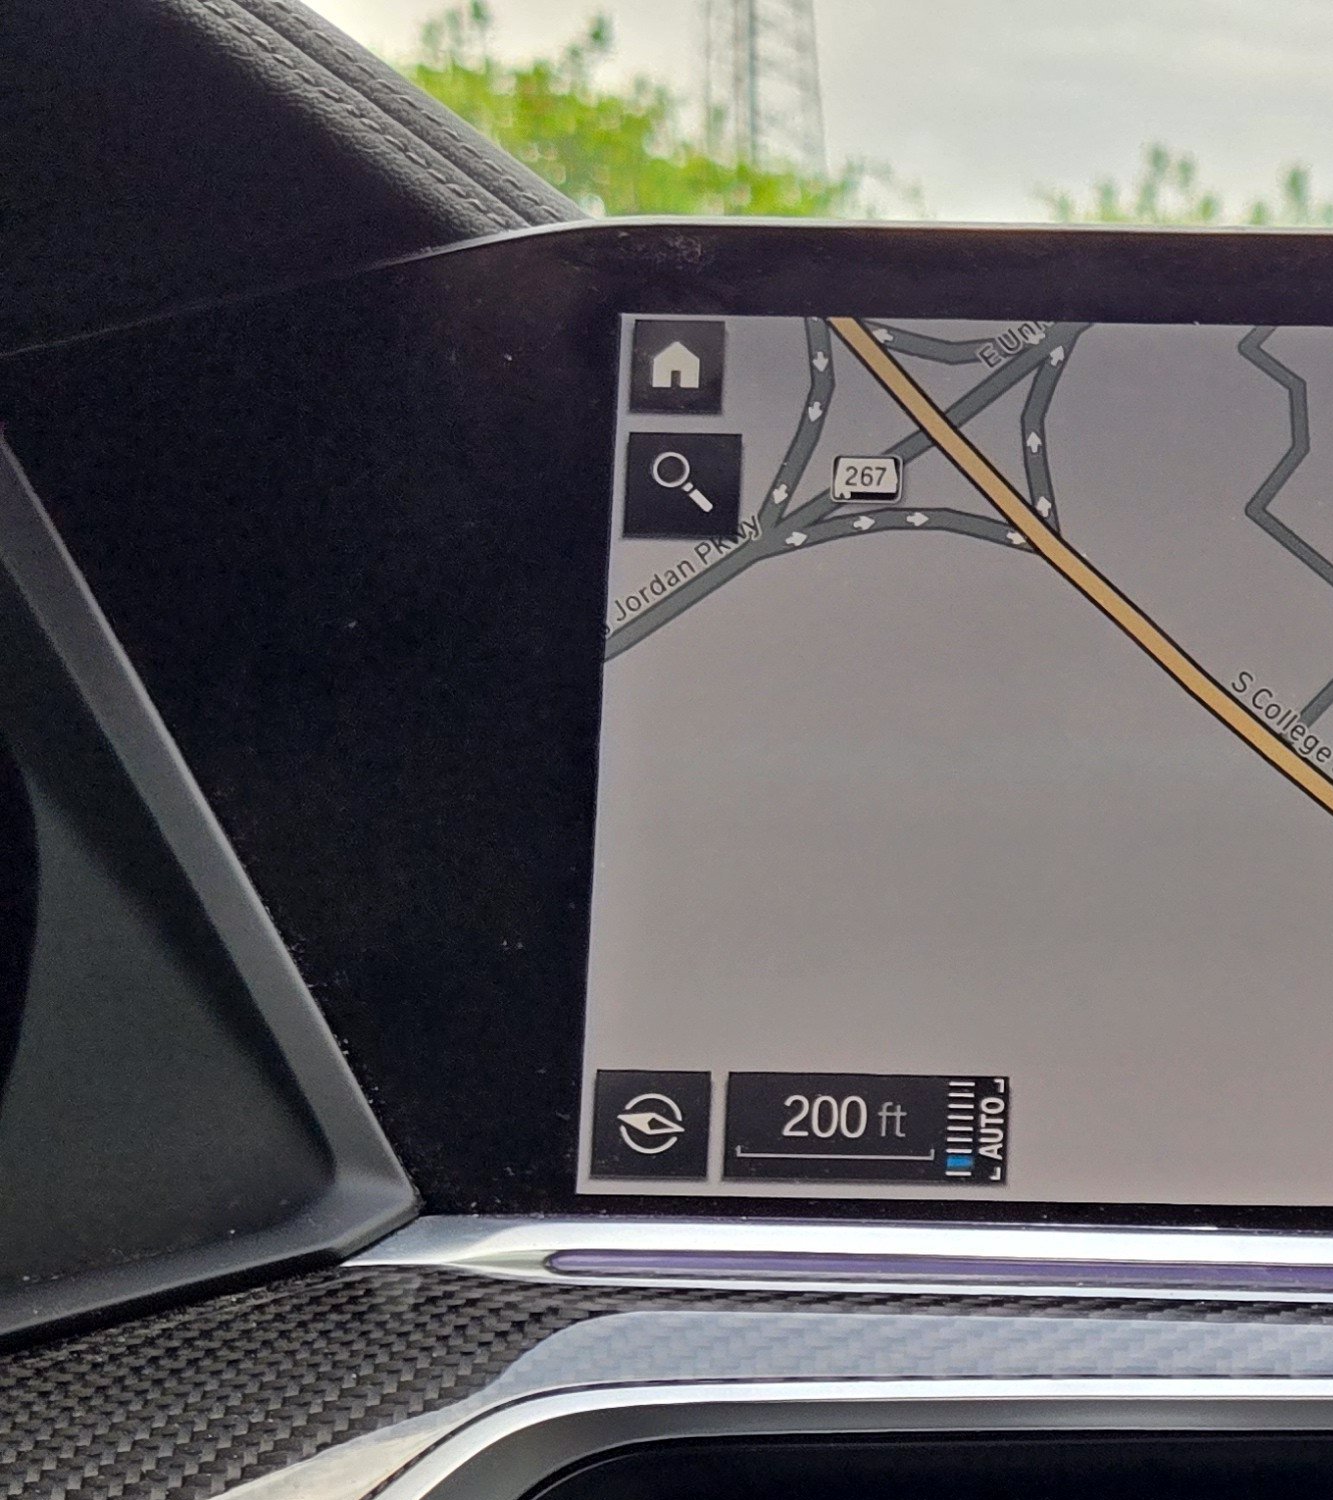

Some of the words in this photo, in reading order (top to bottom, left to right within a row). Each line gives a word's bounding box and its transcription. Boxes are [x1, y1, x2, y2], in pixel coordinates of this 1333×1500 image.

[845, 466, 887, 487] 267
[615, 560, 695, 622] Jordan
[1231, 671, 1254, 693] S
[1252, 688, 1332, 763] College
[782, 1095, 868, 1139] 200
[877, 1101, 907, 1138] ft
[979, 1097, 1005, 1160] AUTO
